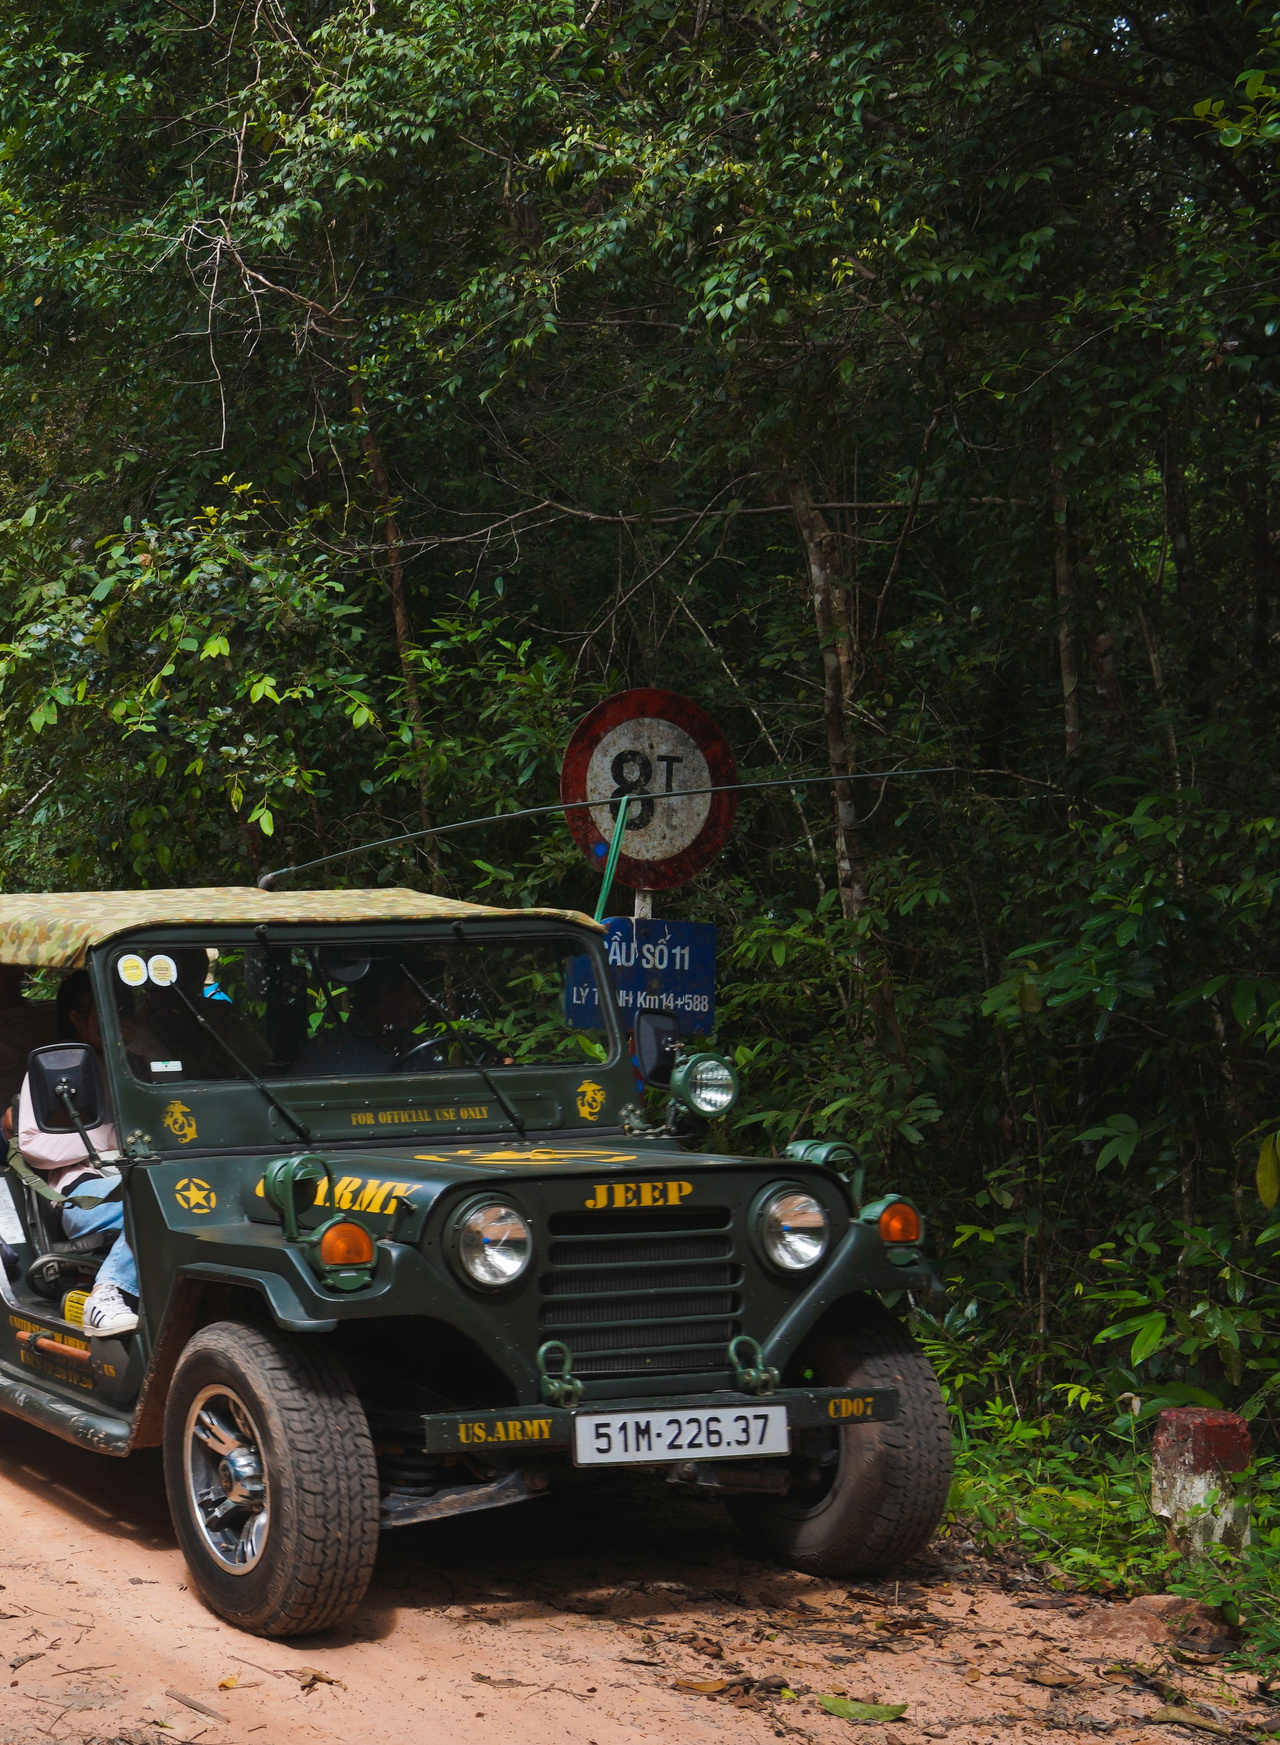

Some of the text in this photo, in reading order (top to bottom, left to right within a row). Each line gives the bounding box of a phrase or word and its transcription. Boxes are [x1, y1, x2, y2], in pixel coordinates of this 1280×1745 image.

[603, 931, 690, 970] ẦU SỐ 11
[573, 983, 590, 1004] LÝ
[351, 1106, 489, 1125] FOR OFFICIAL USE ONLY
[585, 1181, 693, 1210] JEEP
[828, 1397, 874, 1419] CD07
[594, 1413, 769, 1454] 51M-226.37
